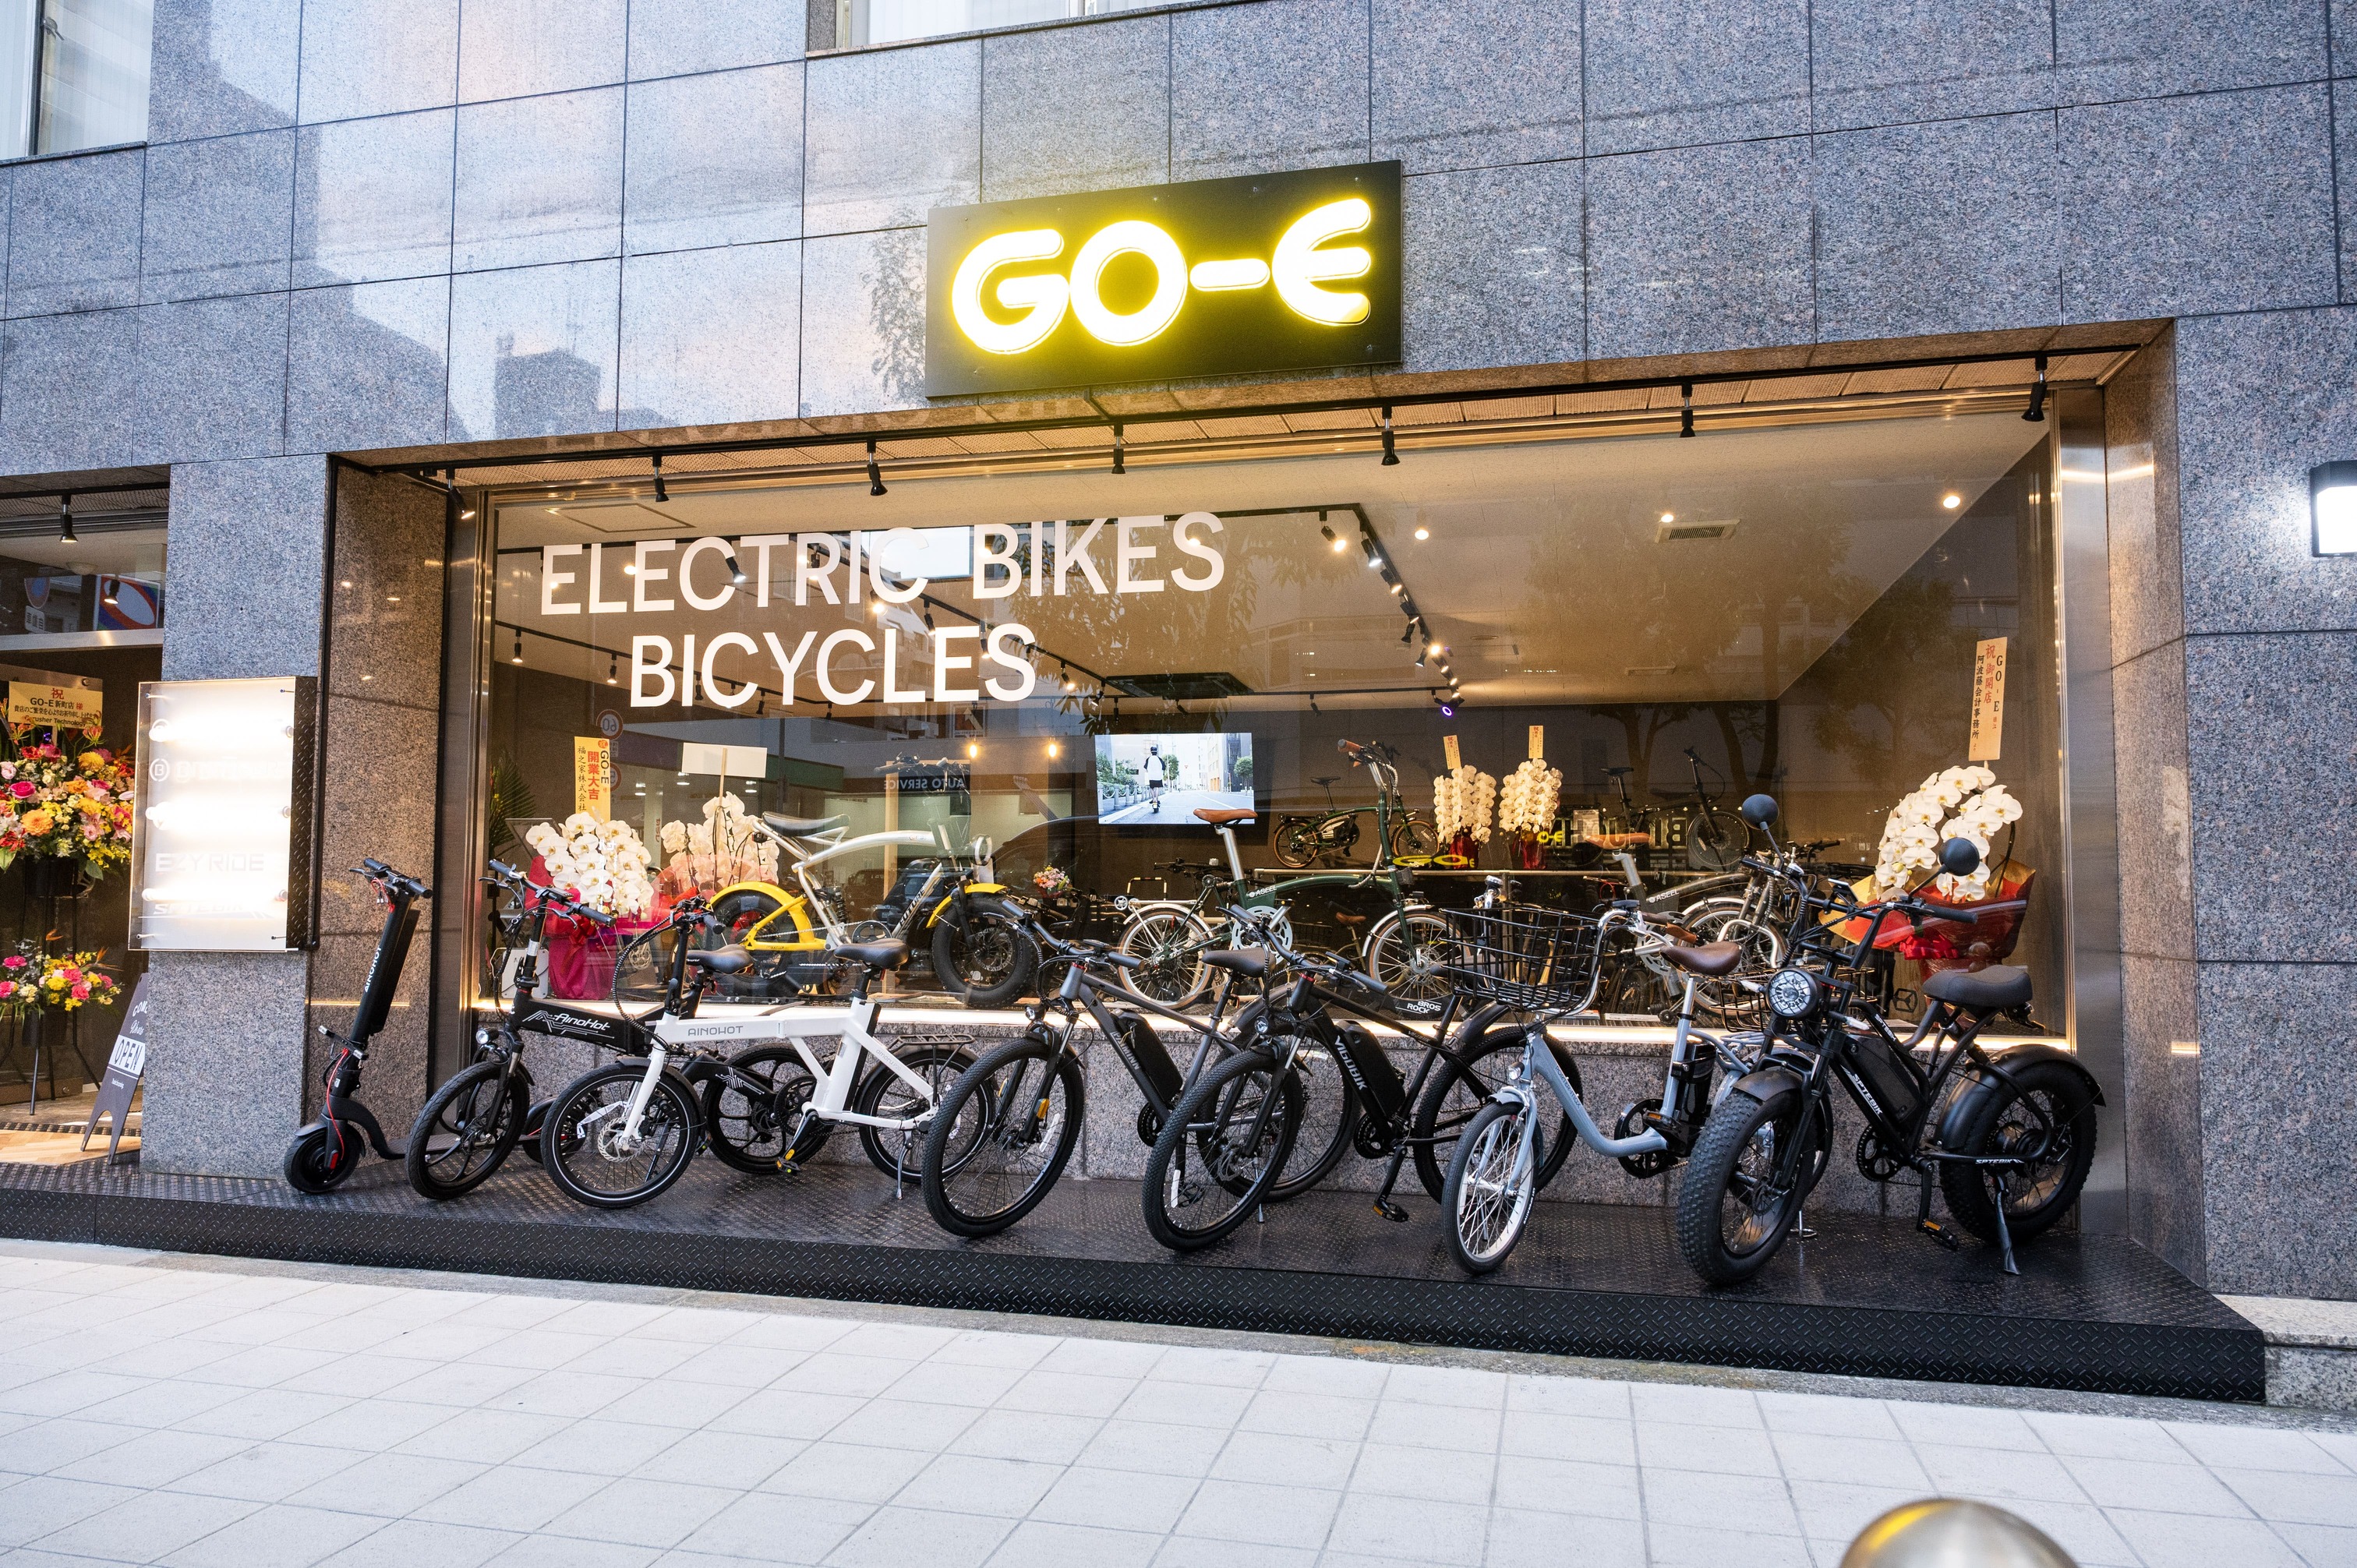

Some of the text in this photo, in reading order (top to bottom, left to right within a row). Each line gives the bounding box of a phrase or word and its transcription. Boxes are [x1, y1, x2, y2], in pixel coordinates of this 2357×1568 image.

[952, 199, 1370, 355] GO-E
[541, 511, 1224, 615] ELECTRIC BIKES
[630, 623, 1036, 708] BICYCLES
[1985, 645, 1996, 659] 祝
[30, 697, 55, 708] GO-E
[51, 687, 64, 700] 祝
[577, 746, 587, 811] 福之家株式会社
[587, 750, 600, 800] 開業大吉
[600, 750, 610, 785] GO-E
[1254, 885, 1277, 896] ASEEL
[1656, 888, 1680, 902] ASEEL
[899, 888, 926, 927] FUTURE
[364, 945, 382, 993] AINOHOT
[1406, 1002, 1430, 1014] ROCK
[1417, 1000, 1442, 1012] BROS
[687, 1026, 744, 1037] AINOHOT
[114, 1039, 143, 1071] OPEN
[1854, 1073, 1883, 1115] SPTEBIK
